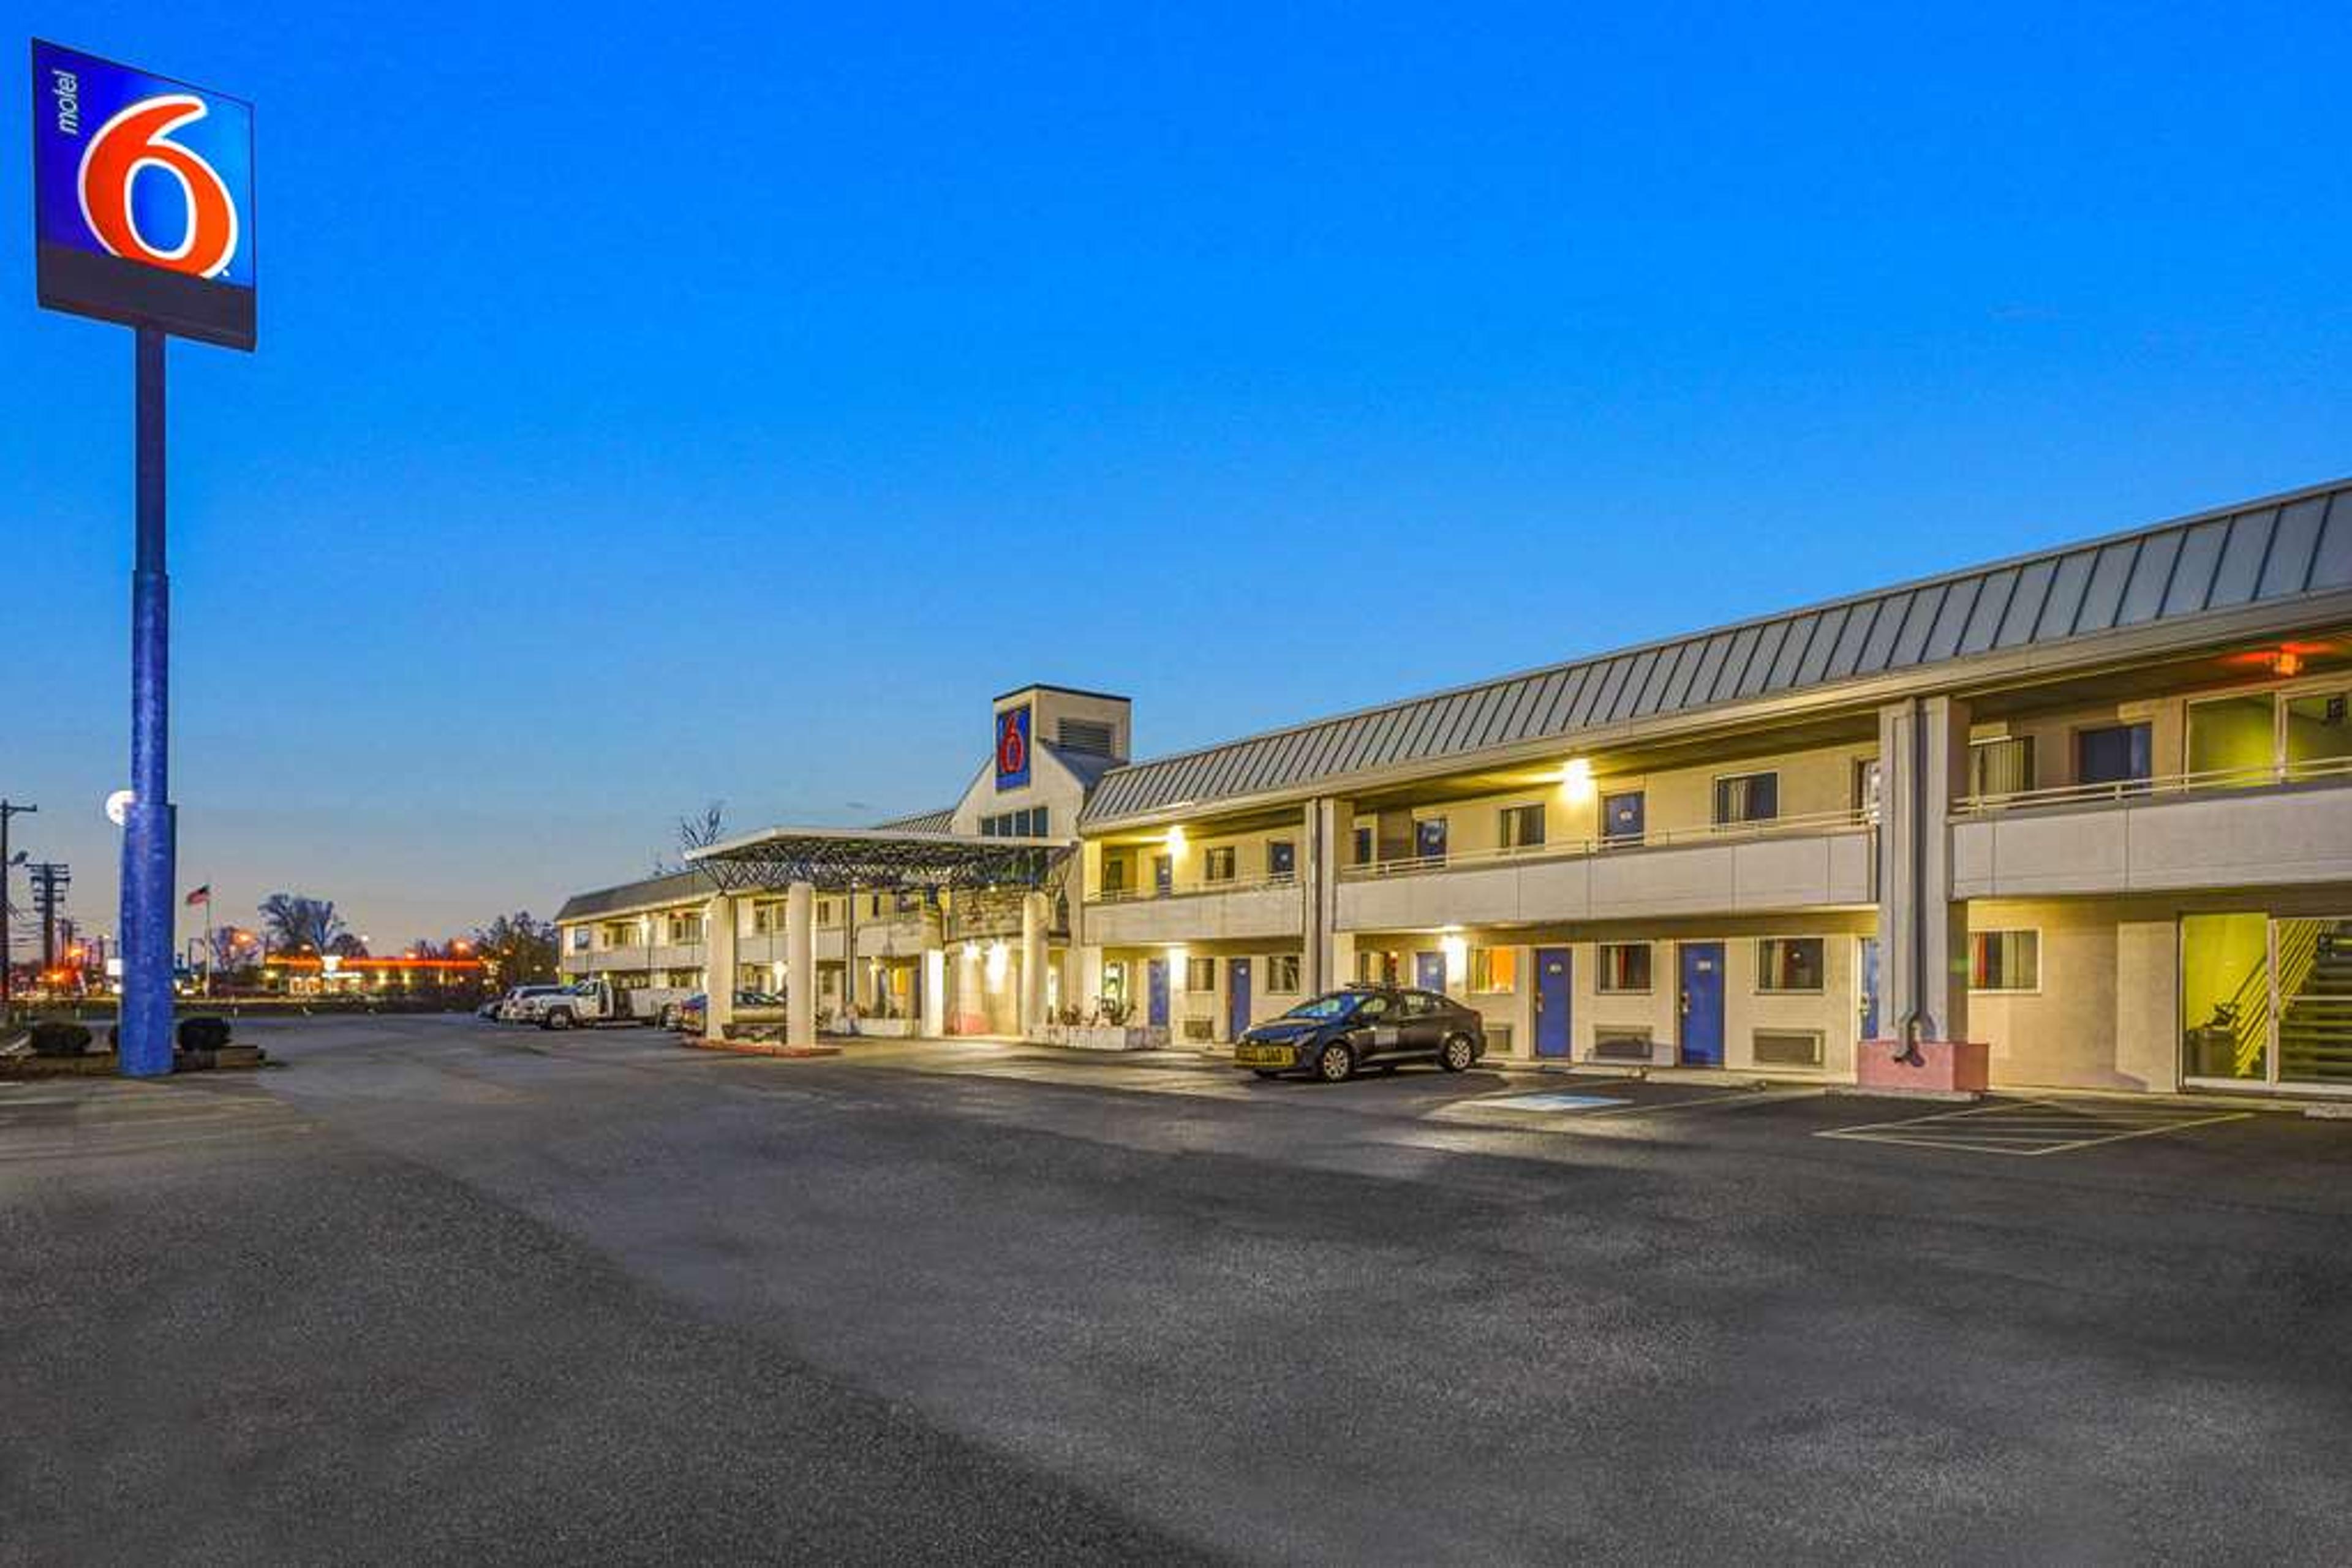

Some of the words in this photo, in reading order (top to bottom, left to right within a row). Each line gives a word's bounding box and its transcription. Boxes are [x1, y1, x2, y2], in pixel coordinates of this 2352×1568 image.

[53, 69, 77, 135] motel
[78, 94, 238, 279] 6
[1000, 708, 1024, 774] 6
